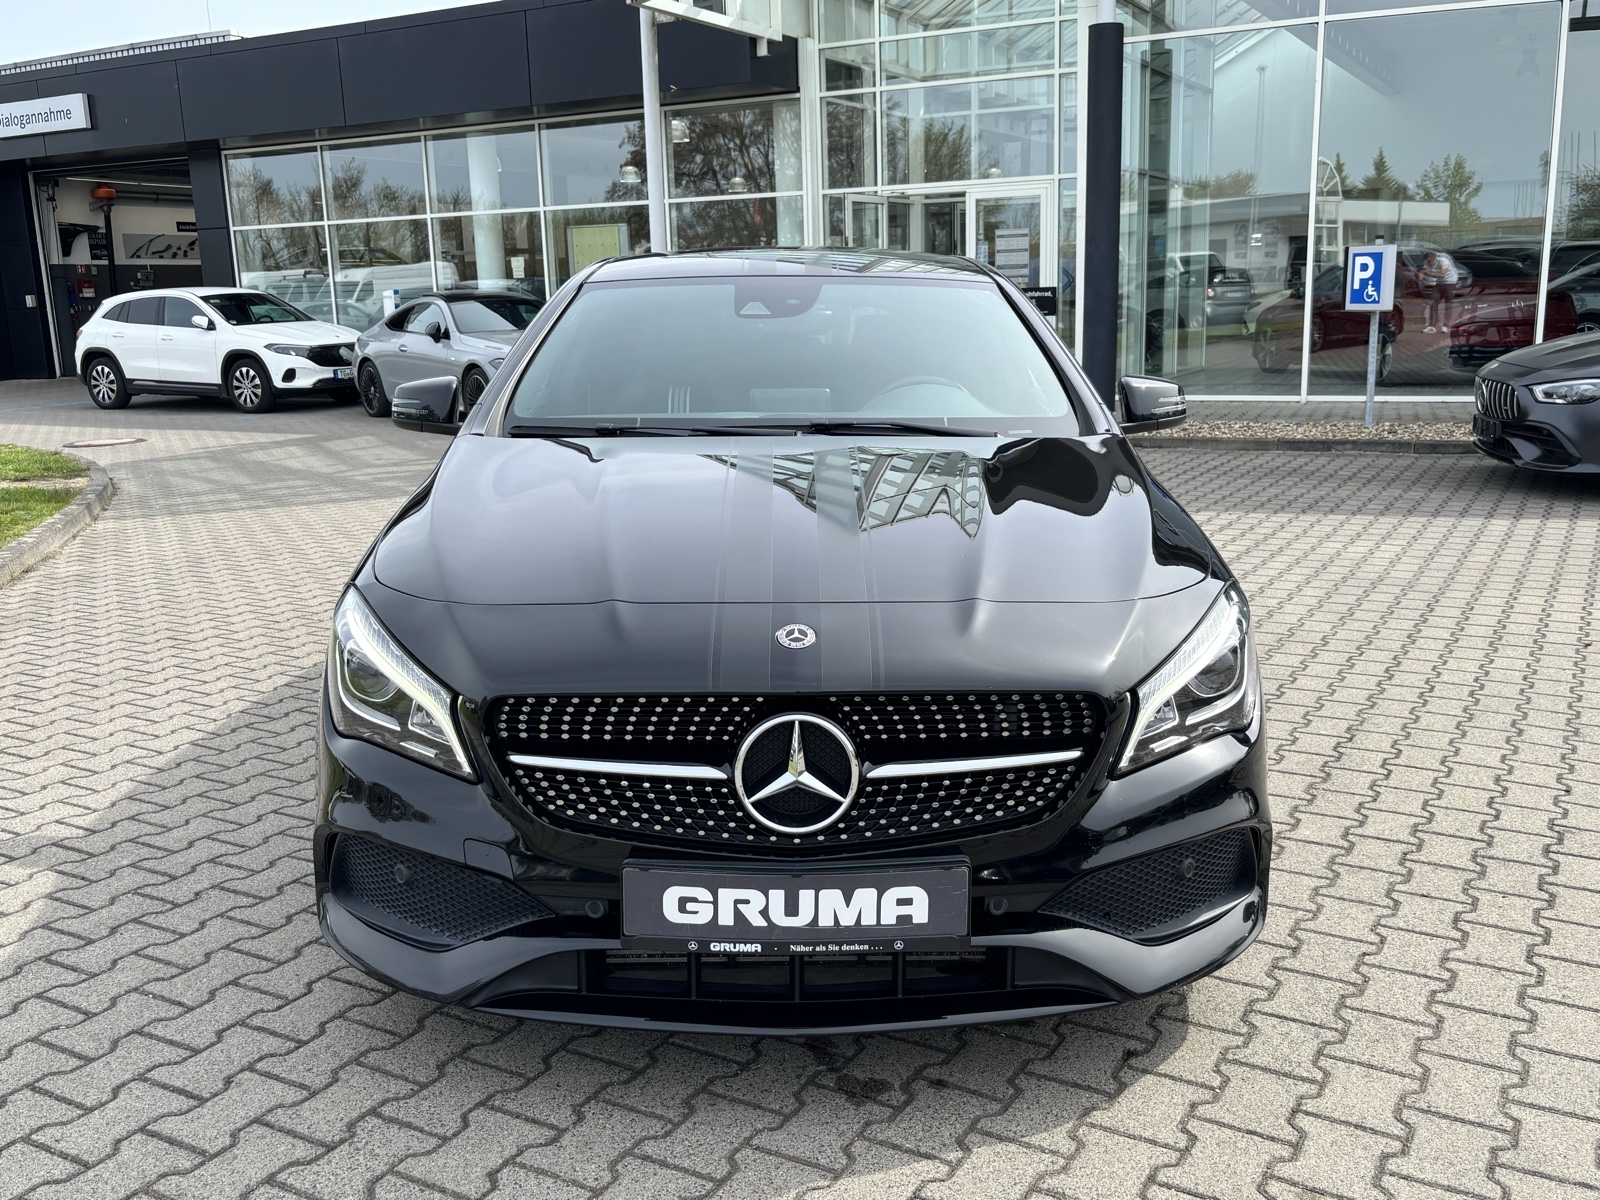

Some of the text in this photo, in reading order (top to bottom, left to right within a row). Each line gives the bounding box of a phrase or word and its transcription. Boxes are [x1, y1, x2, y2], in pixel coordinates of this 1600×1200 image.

[0, 107, 72, 130] ialogannahme
[1353, 255, 1375, 290] P
[662, 885, 929, 927] GRUMA
[710, 942, 762, 953] GRUMA
[789, 944, 814, 952] Näher
[815, 944, 827, 952] als
[827, 943, 840, 952] Sie
[841, 943, 869, 951] denken
